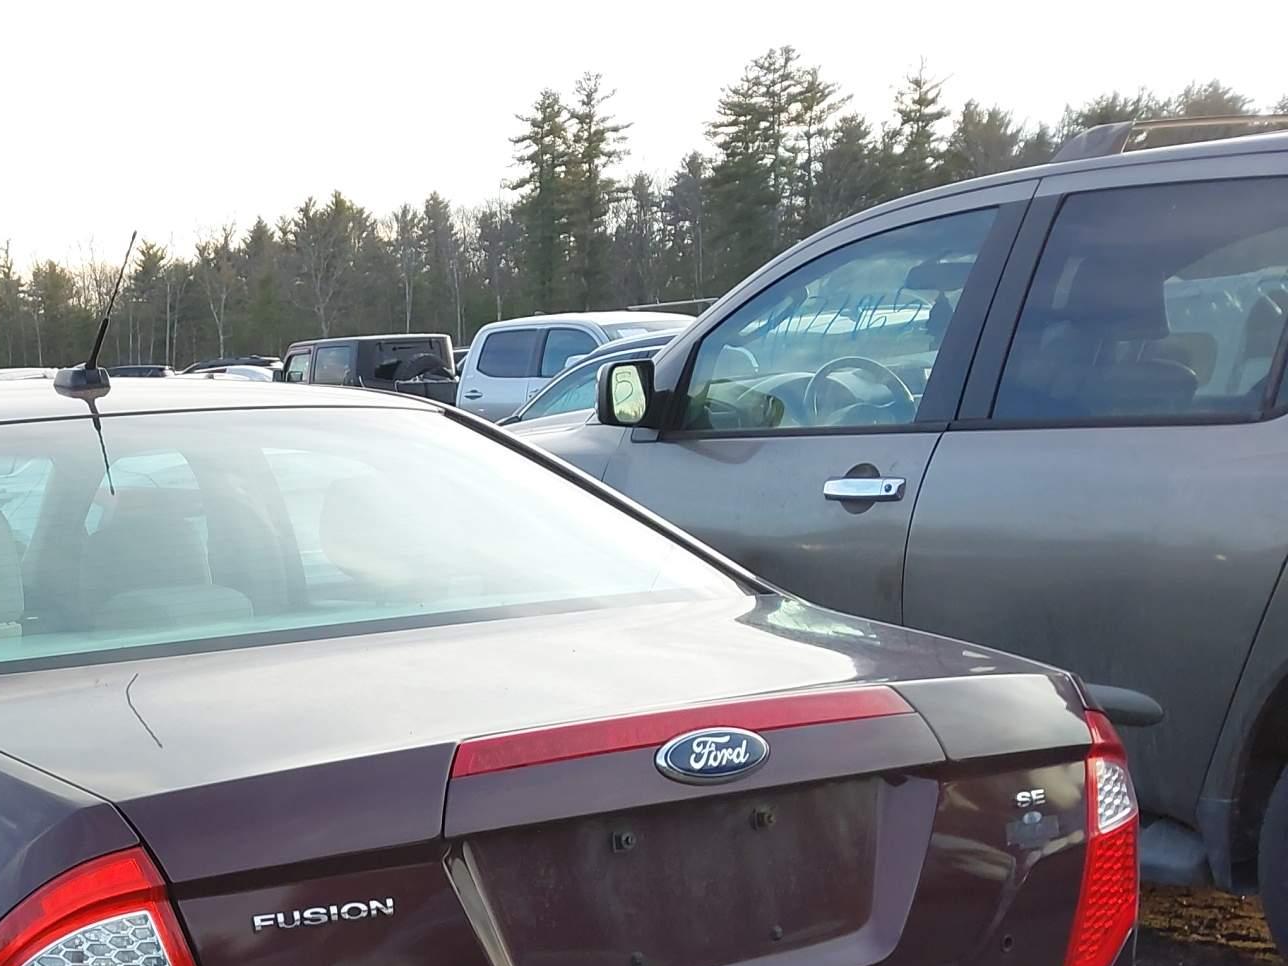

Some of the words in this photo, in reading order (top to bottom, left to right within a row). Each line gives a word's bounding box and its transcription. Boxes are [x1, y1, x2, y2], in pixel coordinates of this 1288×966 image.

[689, 735, 750, 770] Ford
[1015, 788, 1047, 808] SE
[252, 897, 395, 932] FUSION
